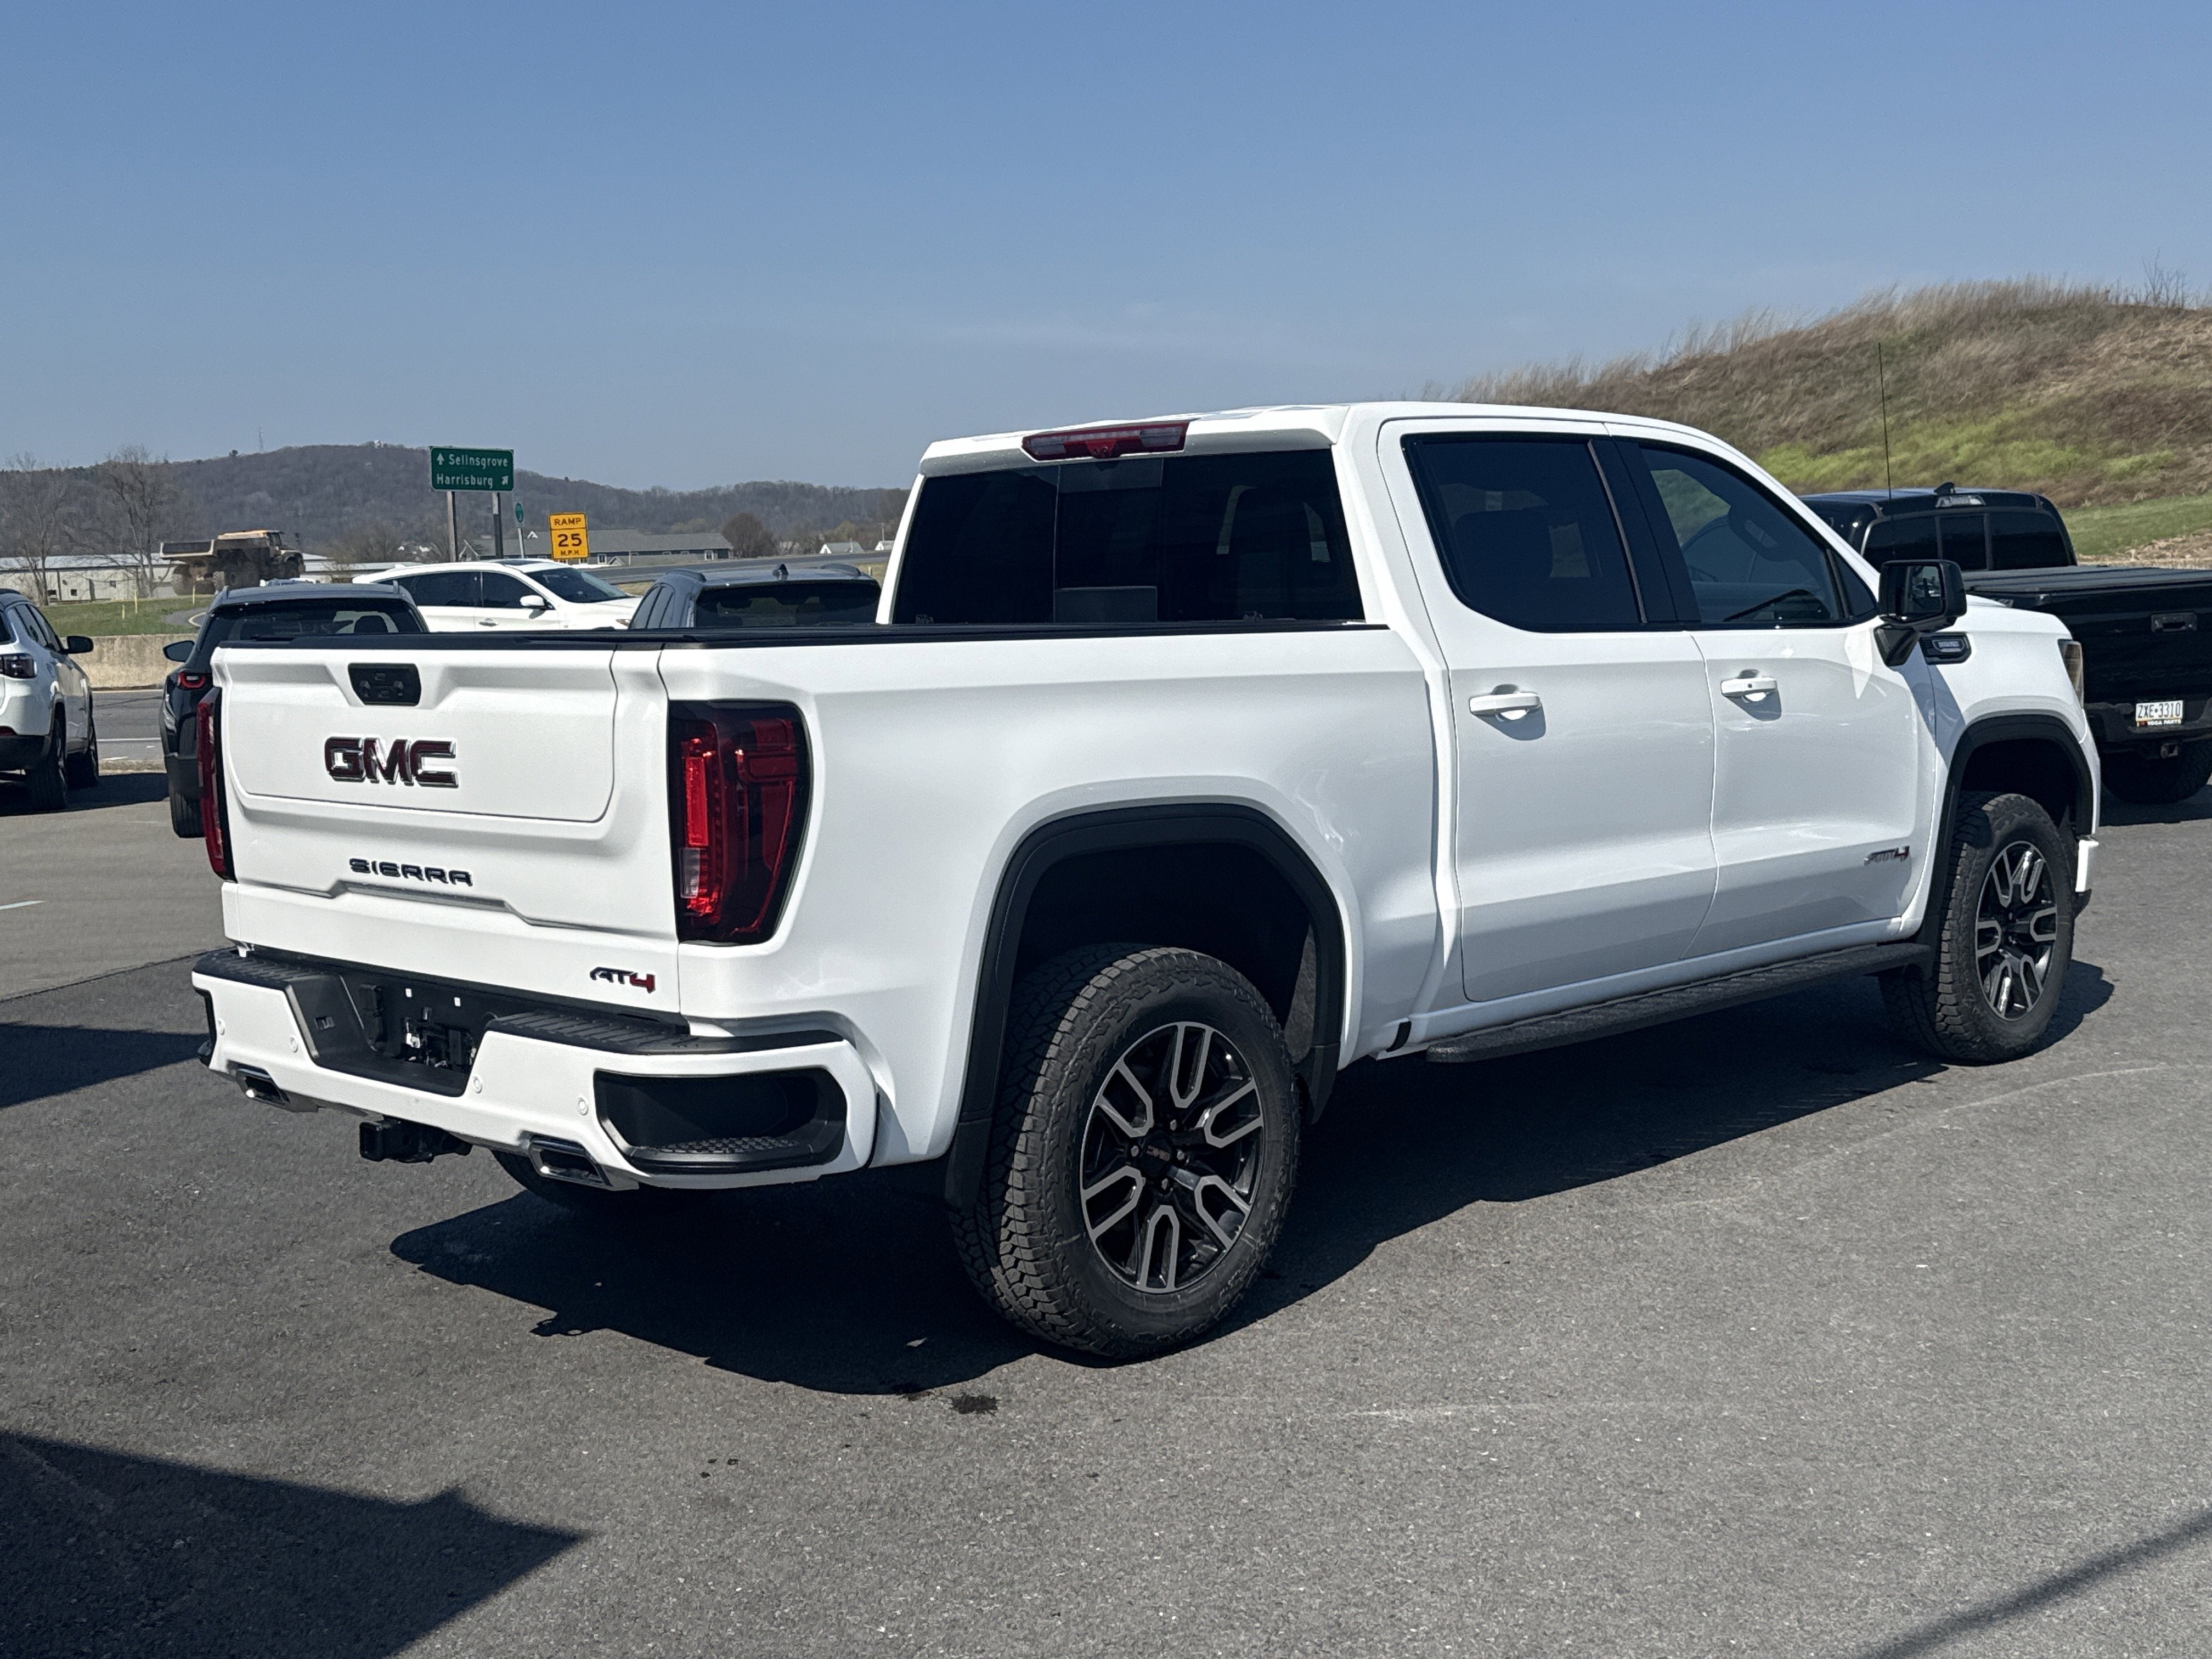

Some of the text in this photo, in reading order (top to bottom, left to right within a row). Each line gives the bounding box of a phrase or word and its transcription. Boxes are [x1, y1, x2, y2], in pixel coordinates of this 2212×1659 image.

[449, 454, 508, 469] Selinsgrove
[437, 473, 493, 489] Harrisburg
[557, 533, 582, 547] 25
[325, 737, 459, 788] GMC
[349, 857, 473, 887] SIERRA
[589, 967, 656, 994] AT4
